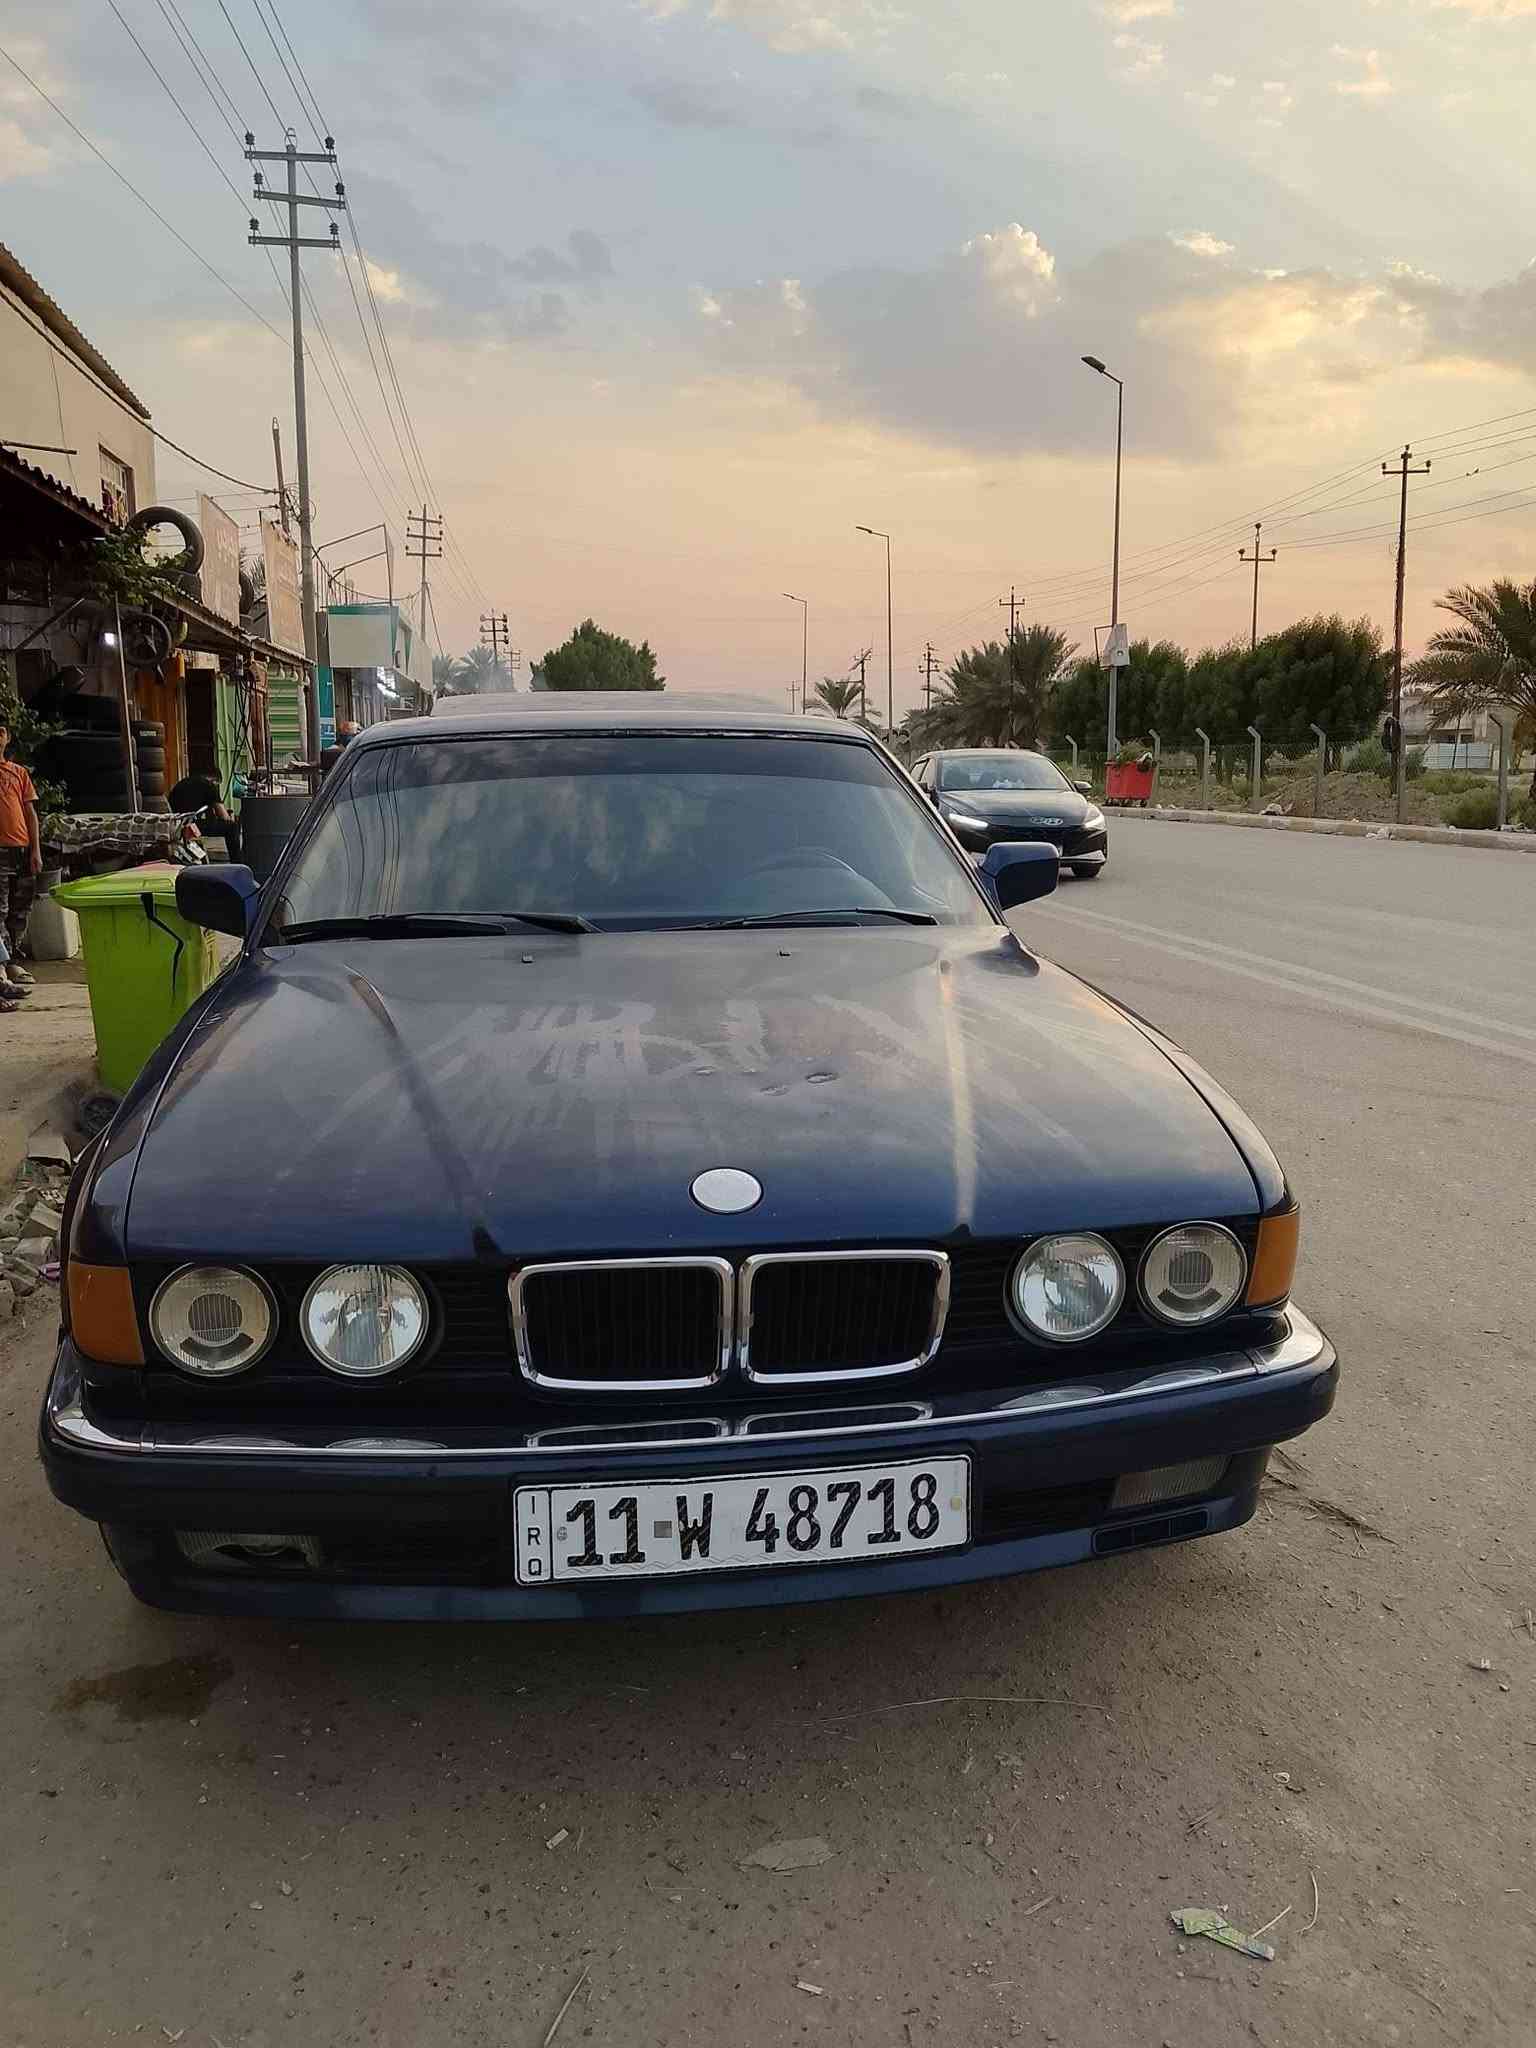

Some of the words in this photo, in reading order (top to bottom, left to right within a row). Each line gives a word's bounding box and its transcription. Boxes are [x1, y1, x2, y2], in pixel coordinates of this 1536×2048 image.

[527, 1495, 542, 1577] IRQ
[565, 1496, 646, 1568] 11
[675, 1492, 714, 1561] W
[745, 1473, 940, 1554] 48718
